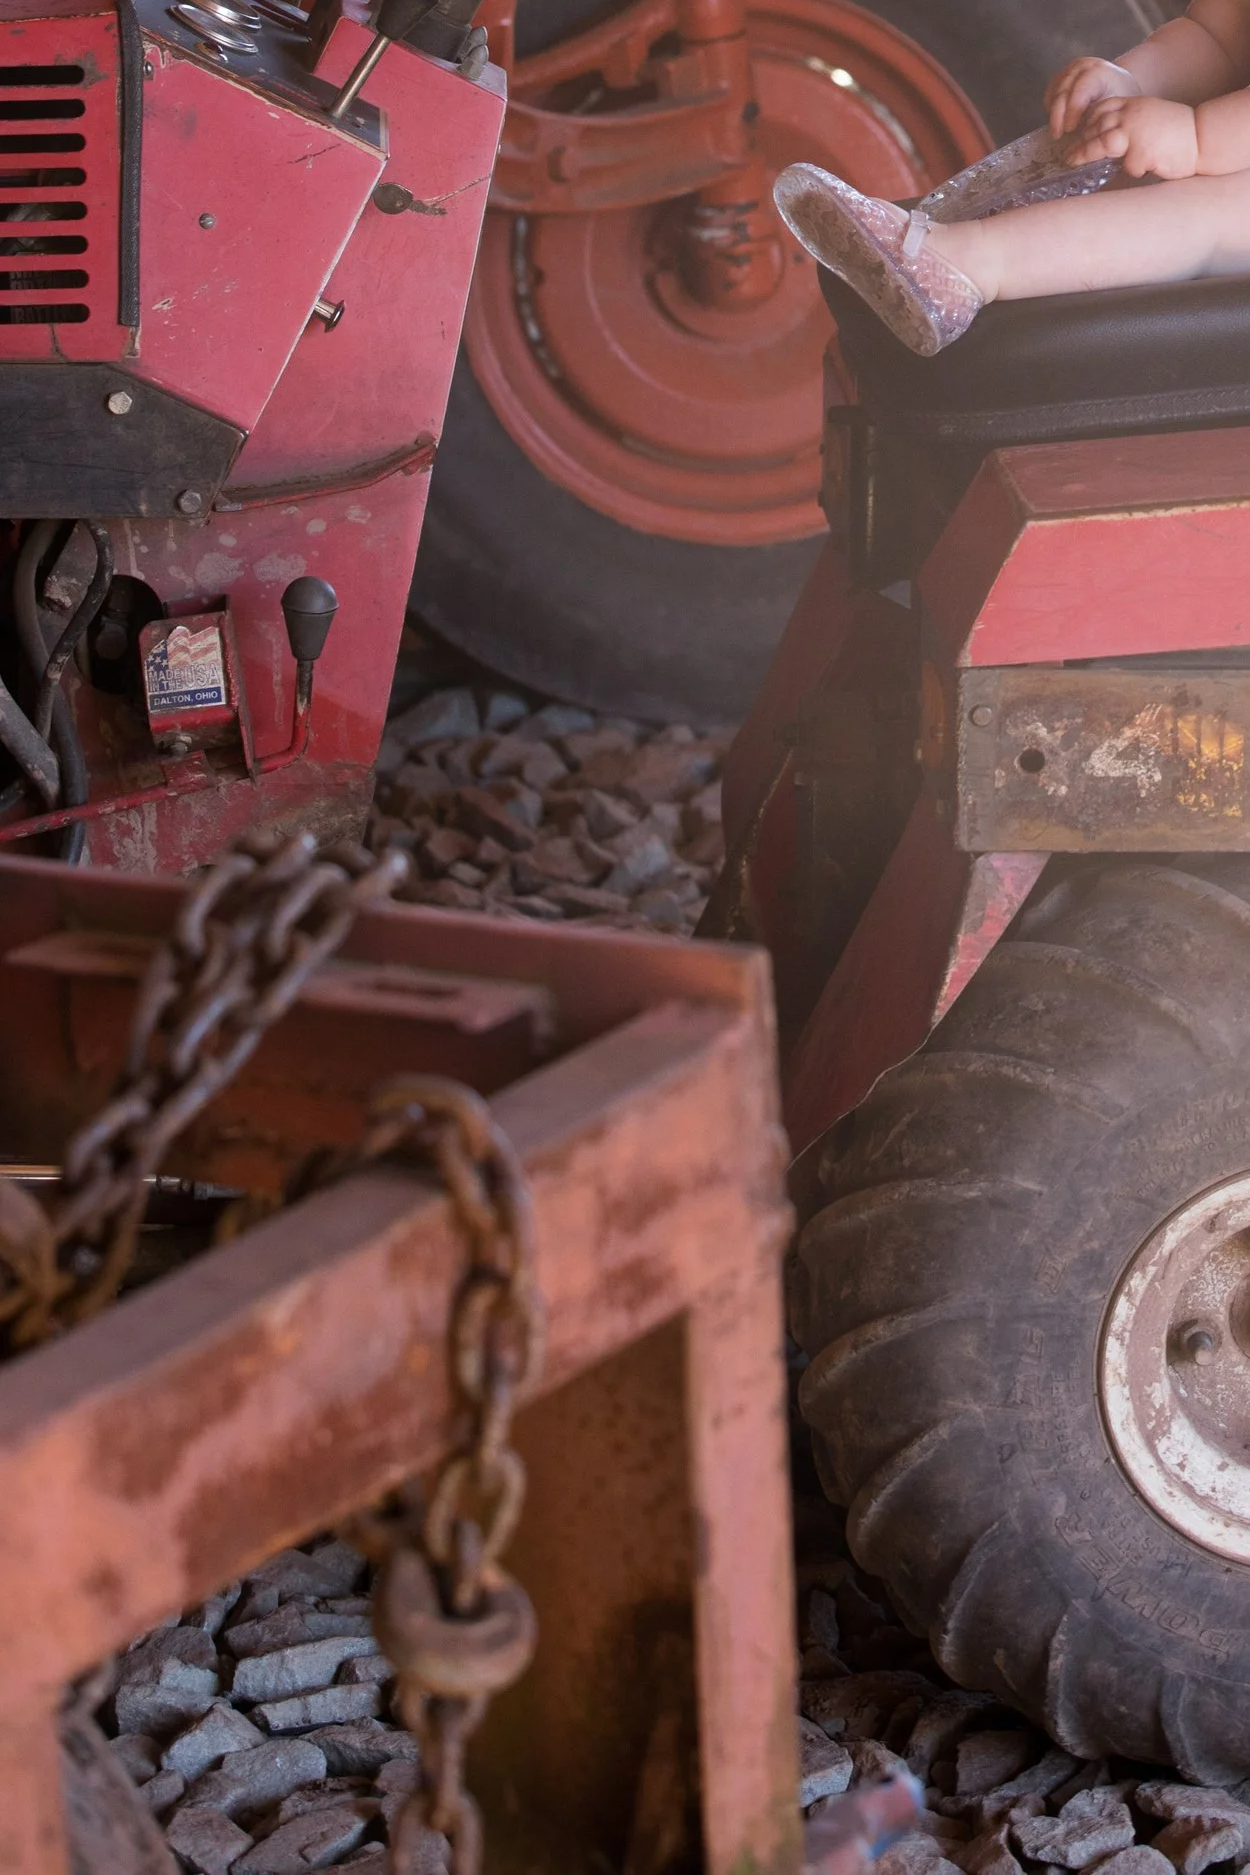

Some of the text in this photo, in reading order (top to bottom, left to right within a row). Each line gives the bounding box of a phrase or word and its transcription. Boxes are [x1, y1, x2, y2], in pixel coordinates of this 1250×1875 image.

[149, 668, 182, 683] MADE
[185, 661, 220, 687] USA
[150, 679, 183, 693] IN THE
[153, 690, 218, 707] DALTON, OHIO
